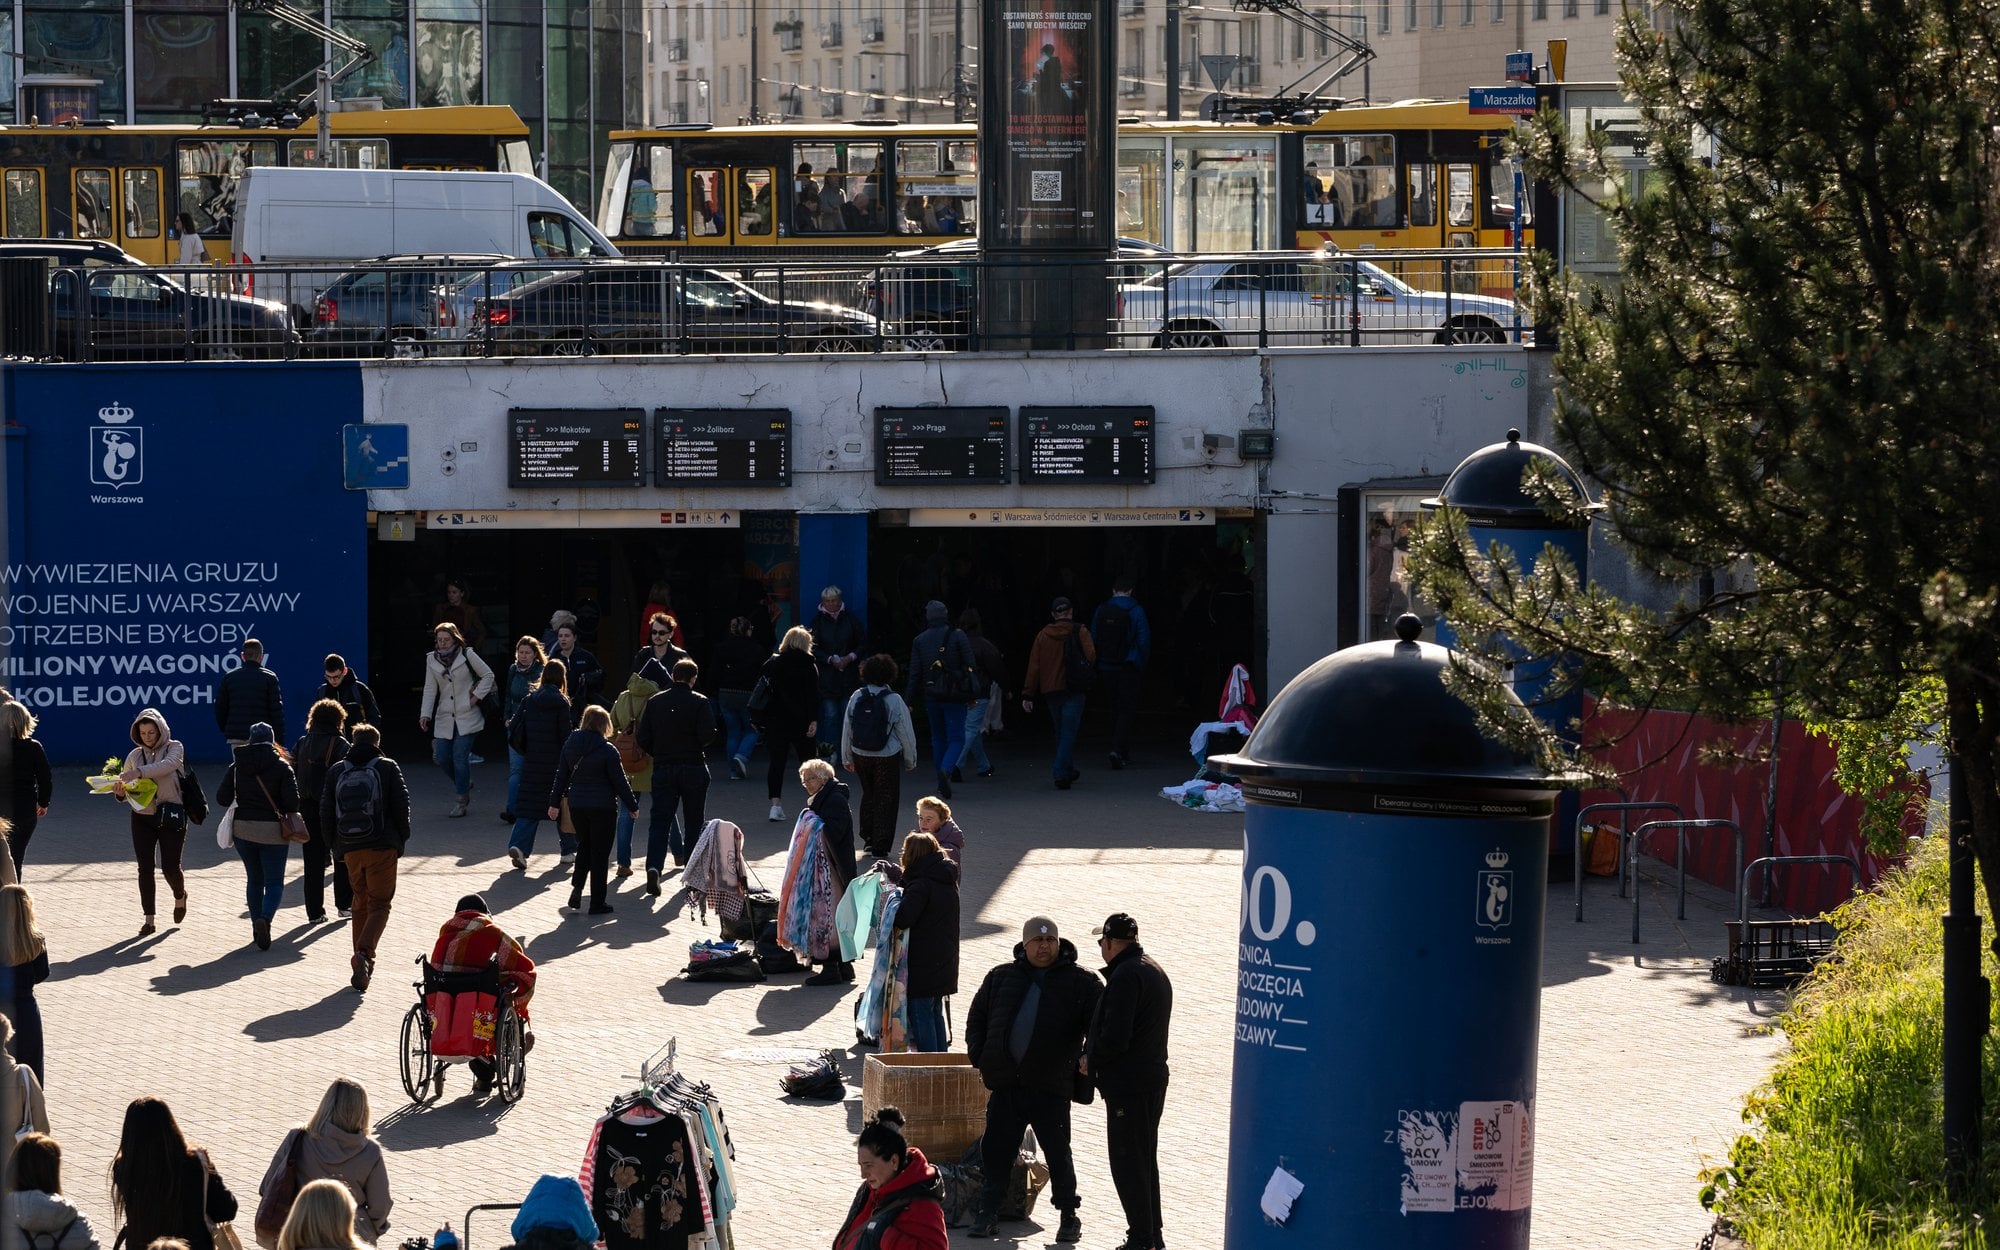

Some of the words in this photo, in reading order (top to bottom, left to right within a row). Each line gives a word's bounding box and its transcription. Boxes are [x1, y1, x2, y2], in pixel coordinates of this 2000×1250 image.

[1003, 11, 1043, 20] ZOSTAWIŁBYŚ
[1045, 12, 1066, 20] SWOJE
[1067, 12, 1092, 20] DZIECKO
[1008, 22, 1025, 30] SAMO
[1027, 22, 1033, 30] W
[1034, 21, 1057, 30] OBCYM
[1059, 20, 1087, 30] MIEŚCIE?
[1484, 95, 1536, 105] Marszałko
[905, 182, 914, 195] 4
[1314, 205, 1325, 223] 4
[560, 426, 591, 434] Mokotów
[706, 424, 735, 433] Żoliborz
[926, 424, 946, 433] Praga
[1071, 423, 1096, 431] Ochota
[90, 495, 144, 504] Warszawa
[480, 514, 498, 524] PKiN
[1005, 513, 1041, 521] Warszawa
[1044, 511, 1087, 521] Śródmieście
[1104, 513, 1140, 521] Warszawa
[1143, 512, 1177, 520] Centralna
[184, 562, 278, 583] GRUZU
[147, 592, 300, 613] WARSZAWY
[0, 624, 141, 646] OTRZEBNE
[148, 623, 255, 644] BYŁOBY
[110, 648, 269, 674] WAGONÓ
[1379, 798, 1410, 809] Operator
[1240, 829, 1316, 946] 0.
[1474, 936, 1511, 944] Warszawa
[1473, 1118, 1484, 1150] STOP
